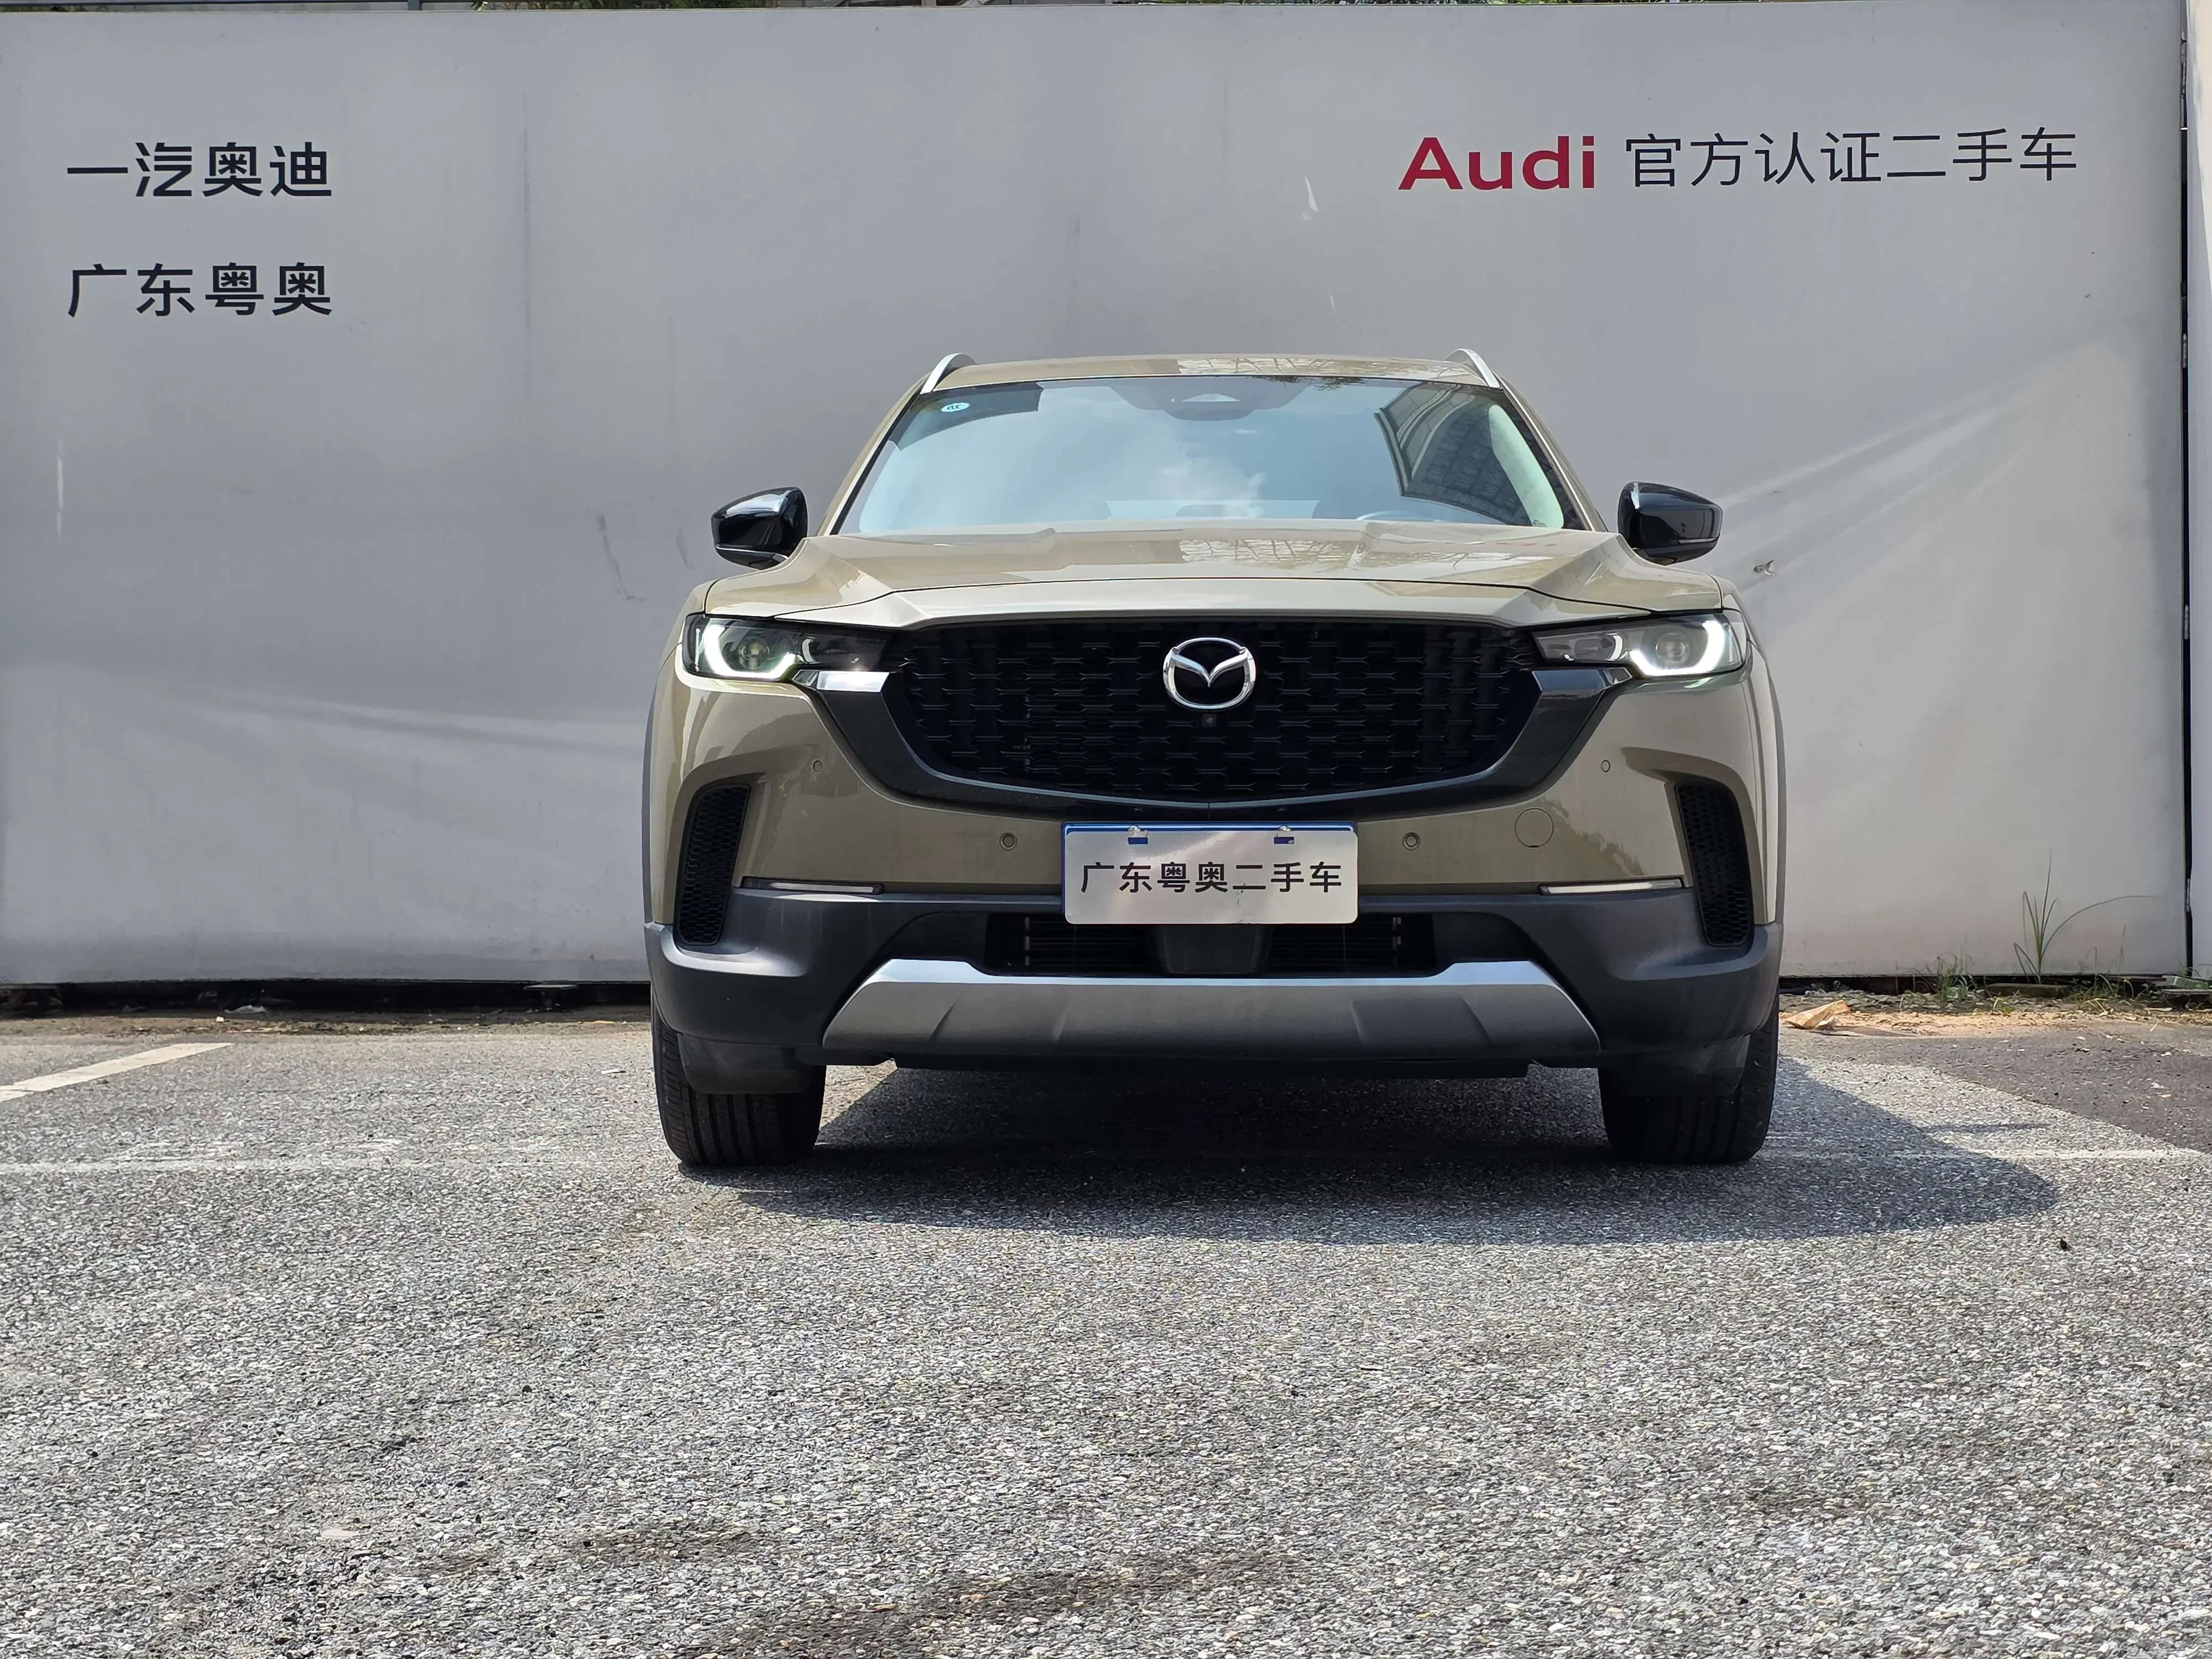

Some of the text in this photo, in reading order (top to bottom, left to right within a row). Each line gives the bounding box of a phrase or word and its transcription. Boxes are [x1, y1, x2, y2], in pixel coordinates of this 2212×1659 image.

[67, 142, 332, 197] 一汽奥迪
[1398, 127, 2077, 190] Audi 官方认证二手车
[67, 262, 332, 317] 广东粤奥
[1081, 861, 1342, 893] 广东粤奥二手车
